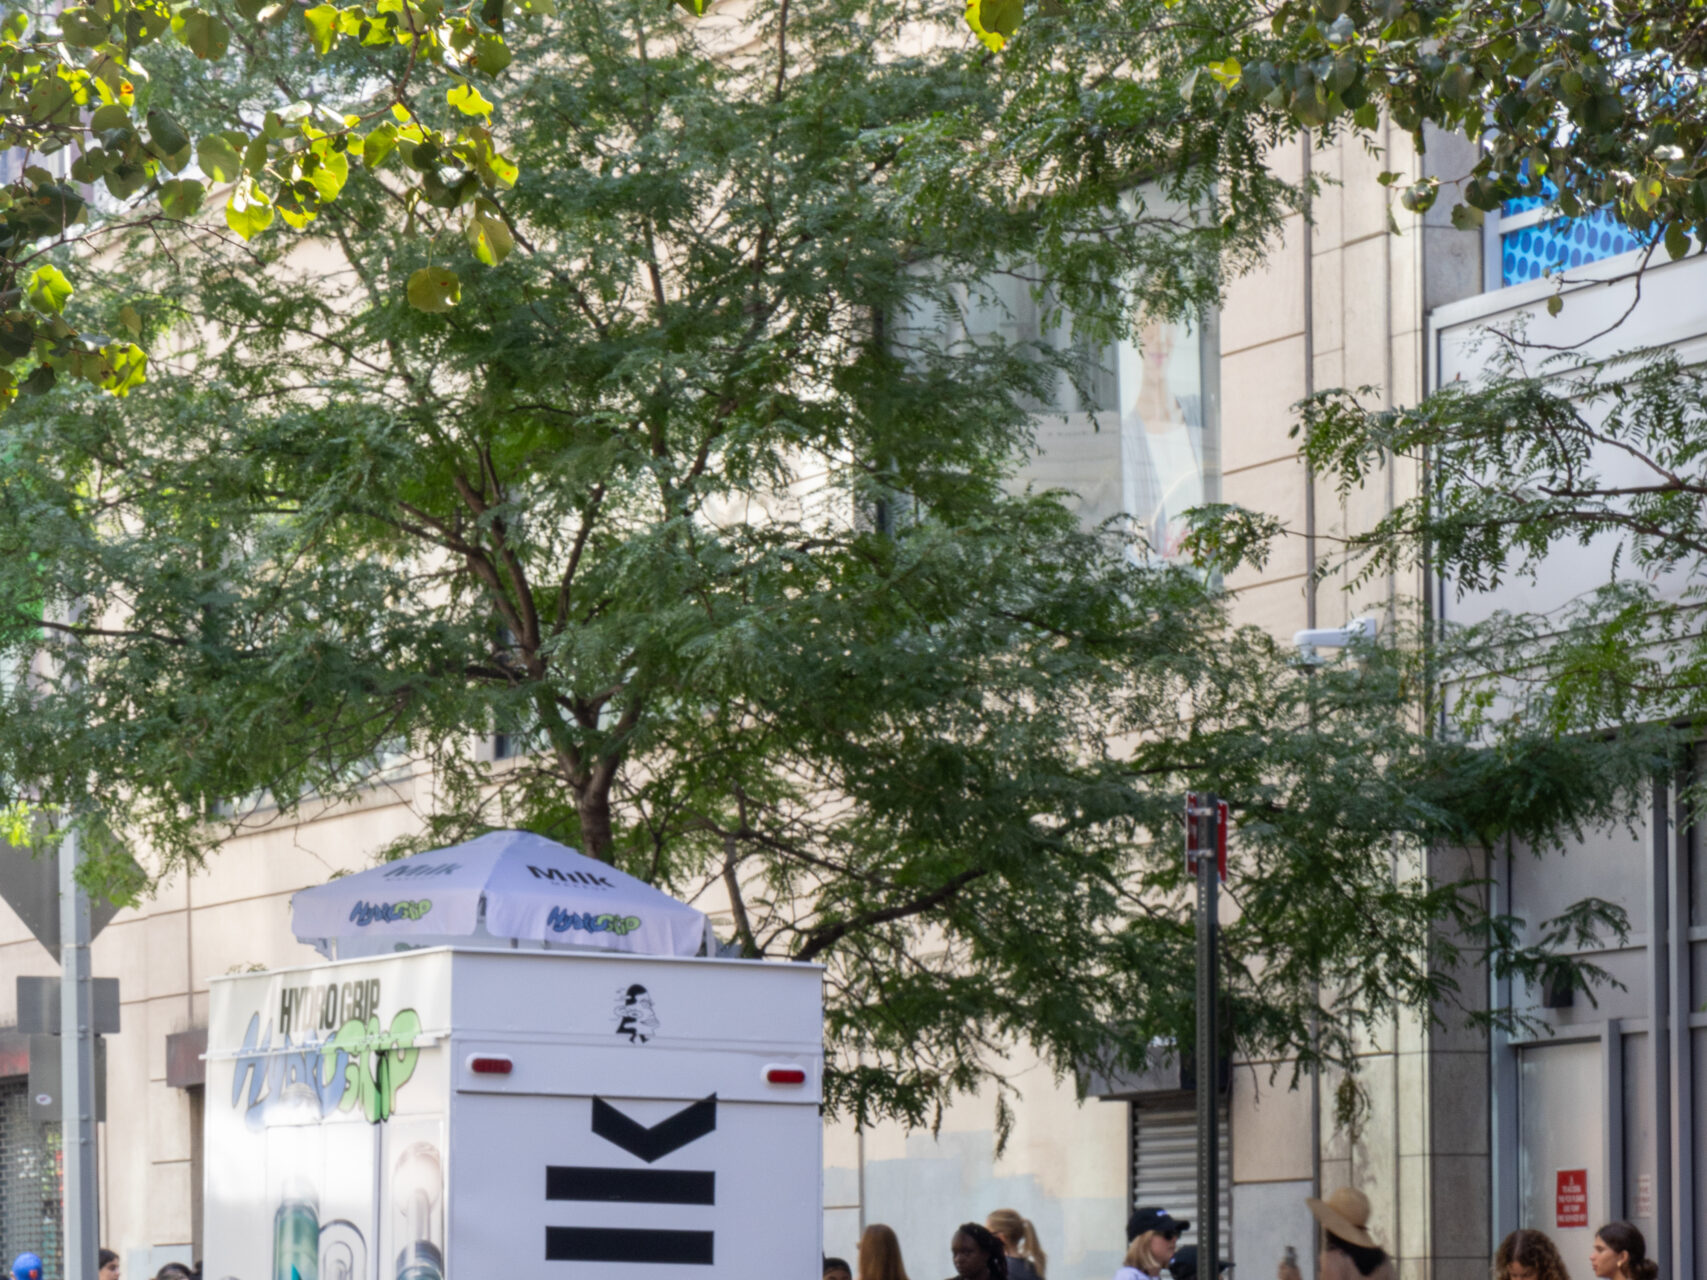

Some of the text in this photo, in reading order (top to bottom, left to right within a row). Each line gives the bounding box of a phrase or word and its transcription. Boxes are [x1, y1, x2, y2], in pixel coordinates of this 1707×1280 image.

[526, 864, 616, 889] Milk
[279, 978, 381, 1034] HYDRO GRIP
